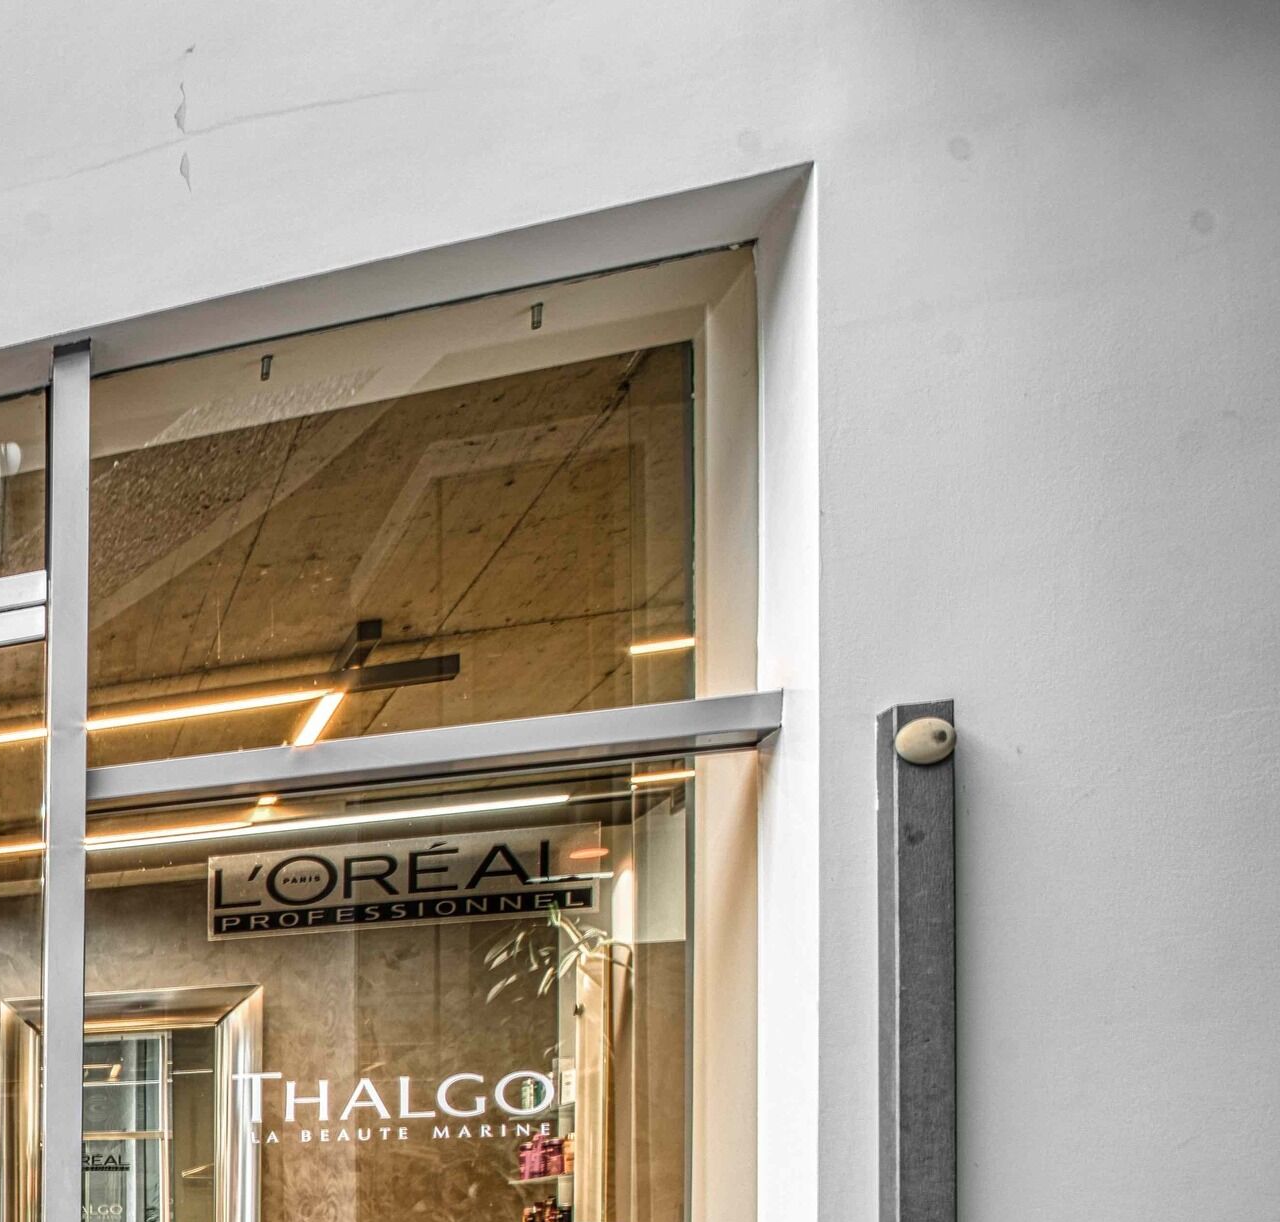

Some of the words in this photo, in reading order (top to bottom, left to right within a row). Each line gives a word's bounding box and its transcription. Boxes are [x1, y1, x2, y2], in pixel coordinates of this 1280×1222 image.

[214, 840, 593, 910] L'ORÉAL
[282, 874, 322, 886] PARIS
[220, 891, 585, 932] PROFESSIONNEL
[231, 1070, 556, 1123] THALGO
[250, 1130, 279, 1145] LA
[432, 1122, 551, 1139] MARINE
